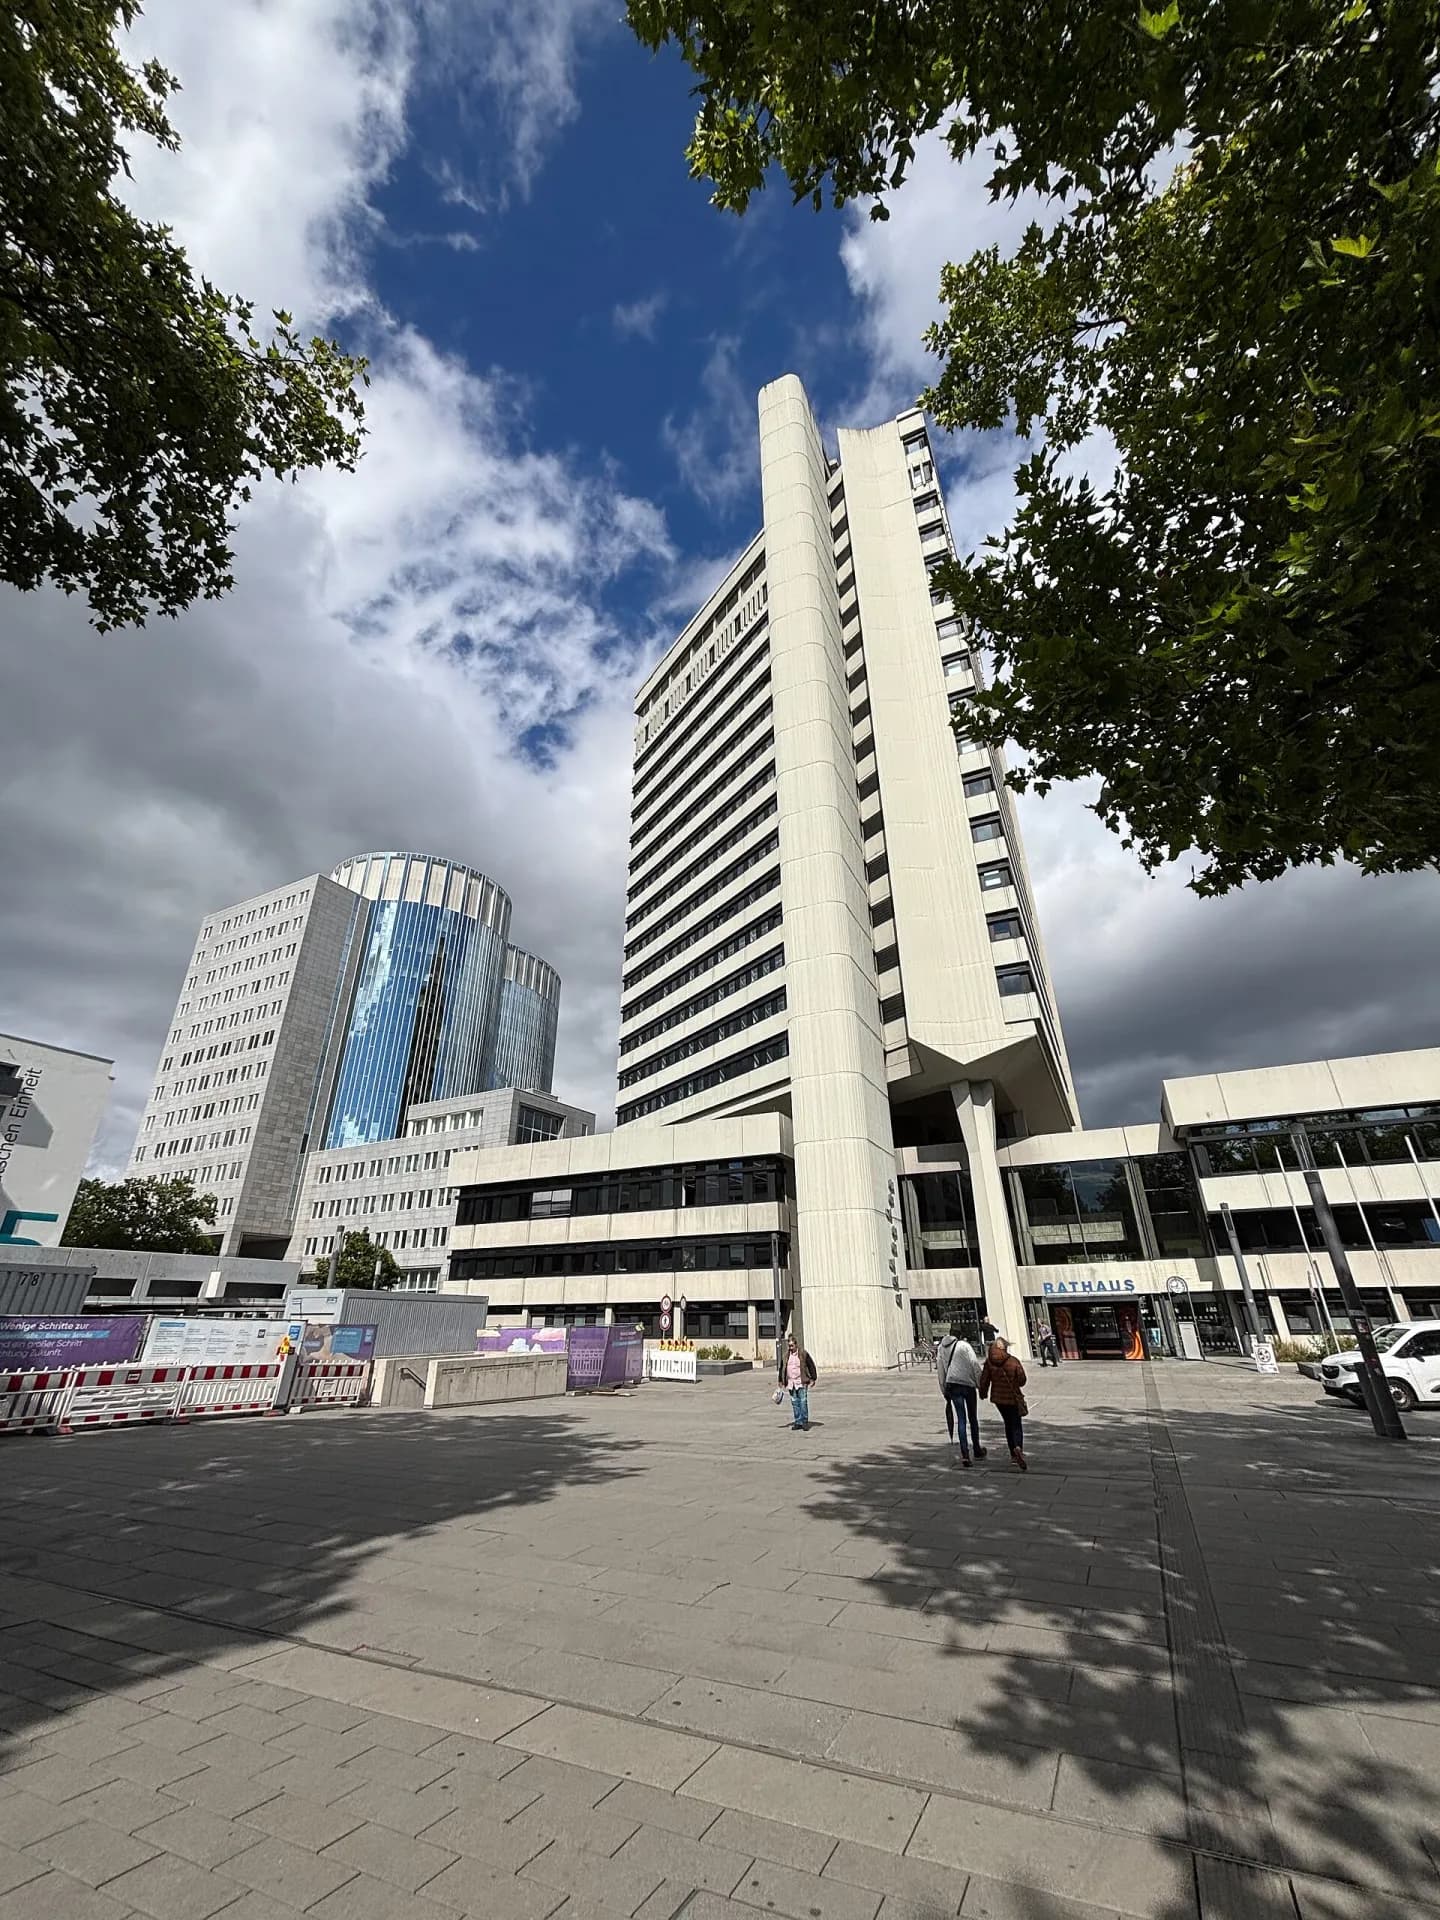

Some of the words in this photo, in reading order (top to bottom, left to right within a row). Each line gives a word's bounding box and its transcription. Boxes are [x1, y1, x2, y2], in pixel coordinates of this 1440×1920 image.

[9, 1067, 43, 1119] Einheit
[0, 1124, 22, 1182] schen
[1043, 1280, 1135, 1293] RATHAUS
[0, 1322, 36, 1332] Wenige
[38, 1322, 73, 1330] Schritte
